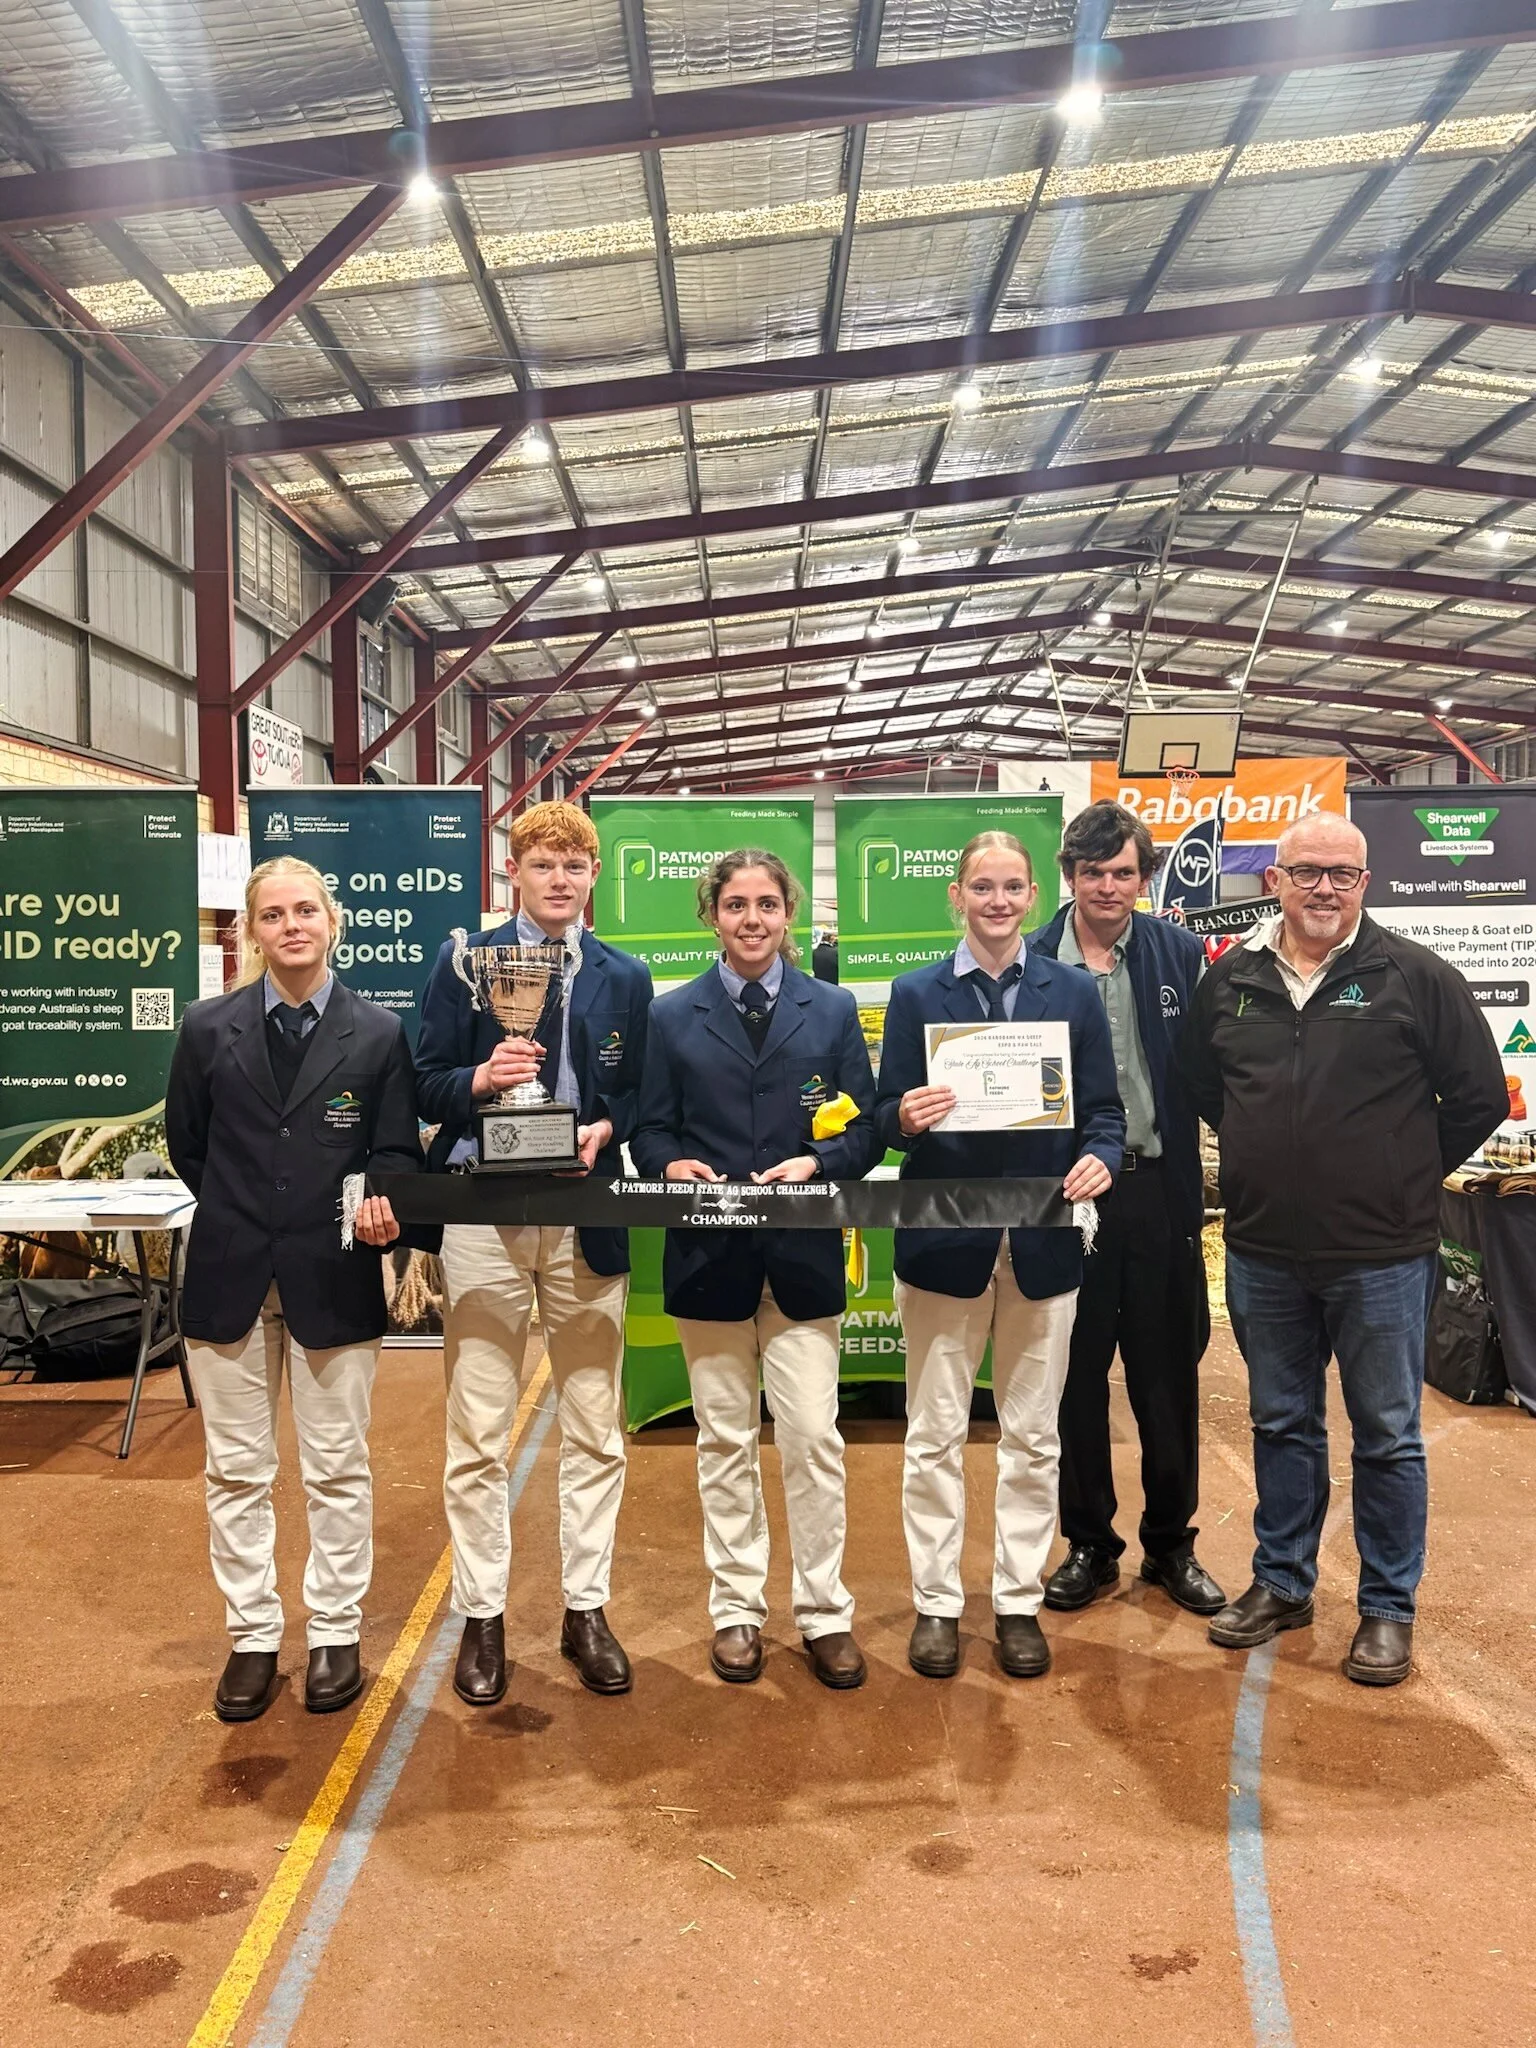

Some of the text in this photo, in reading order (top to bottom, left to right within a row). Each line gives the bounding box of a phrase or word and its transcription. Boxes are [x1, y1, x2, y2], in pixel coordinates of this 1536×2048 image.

[252, 713, 271, 737] GREAT
[267, 743, 291, 769] TOYOTA
[1117, 783, 1325, 825] Rabobank
[730, 811, 756, 819] Feeding
[976, 808, 1003, 816] Feeding
[1024, 807, 1047, 815] Simple
[1427, 812, 1486, 824] Shearwell
[433, 815, 461, 823] Protect
[148, 823, 170, 831] Grow
[433, 823, 454, 831] Grow
[1442, 825, 1471, 837] Data
[148, 831, 182, 839] Innovate
[433, 831, 466, 839] Innovate
[1459, 844, 1489, 852] Systems
[903, 849, 964, 863] PATMO
[903, 865, 955, 878] FEEDS
[349, 872, 387, 892] on
[396, 868, 464, 893] eIDs
[1389, 879, 1527, 895] Tag well with Shearwell
[0, 893, 120, 925] re you
[338, 901, 413, 934] heep
[1193, 903, 1283, 933] RANGEVIE
[1386, 924, 1533, 937] The WA Sheep & Goat eID
[0, 929, 182, 968] ID ready?
[1424, 941, 1456, 952] ntive
[1458, 941, 1508, 953] Payment
[335, 939, 424, 970] goats
[652, 951, 702, 964] QUALITY
[847, 952, 893, 965] SIMPLE,
[895, 951, 945, 963] QUALITY
[1446, 957, 1536, 968] ended into 202
[11, 987, 52, 999] working
[54, 987, 76, 997] with
[78, 987, 118, 999] industry
[357, 988, 414, 999] fully accredited
[1472, 988, 1519, 1002] per tag!
[38, 1003, 91, 1014] Australia's
[93, 1003, 124, 1015] sheep
[372, 1000, 416, 1008] entification
[2, 1020, 123, 1033] goat traceability system.
[621, 1182, 828, 1196] PATMORE FEEDS STATE AG SCHOOL CHALLENGE
[690, 1214, 758, 1225] CHAMPION
